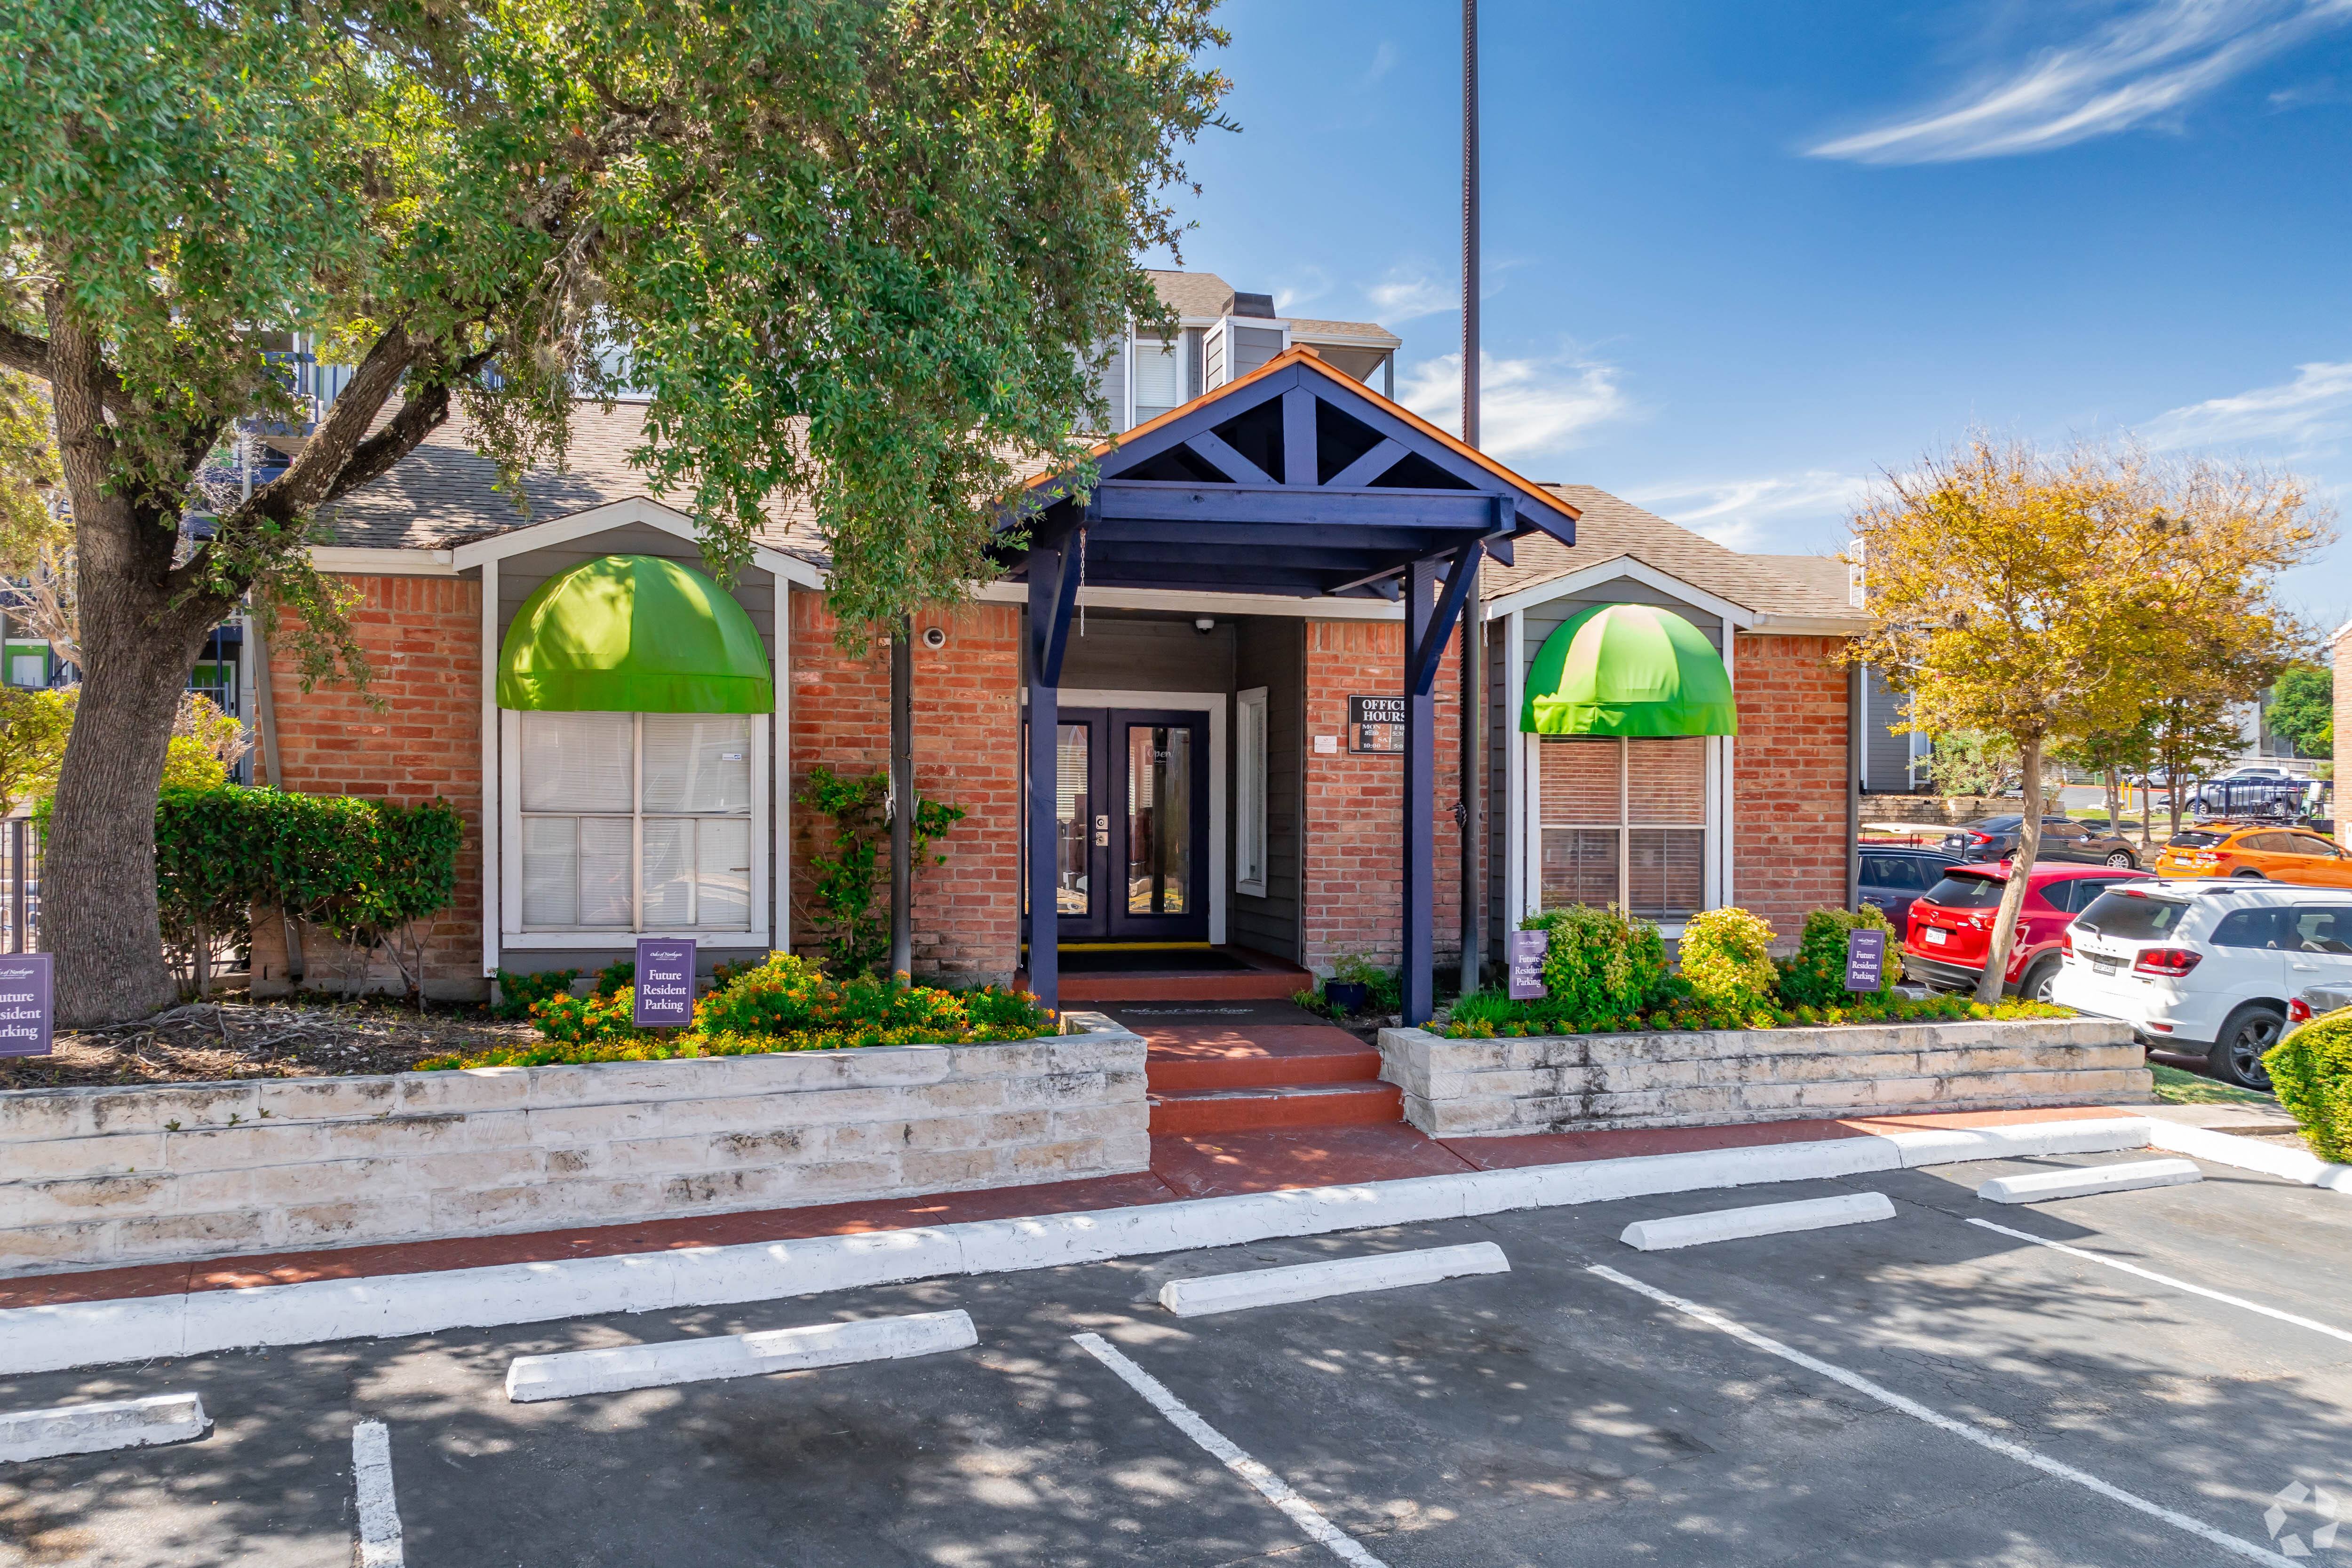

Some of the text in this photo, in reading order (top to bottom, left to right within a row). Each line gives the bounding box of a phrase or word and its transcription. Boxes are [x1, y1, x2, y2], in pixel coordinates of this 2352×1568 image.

[1363, 711, 1405, 721] HOURS
[1147, 748, 1172, 760] Open
[1856, 950, 1876, 959] Future
[1851, 961, 1877, 969] Resident
[649, 969, 682, 980] Future
[1852, 971, 1875, 982] Parking
[1517, 977, 1541, 988] Parking
[643, 983, 686, 995] Resident
[0, 993, 34, 1003] uture
[644, 998, 683, 1013] Parking
[0, 1006, 41, 1020] sident
[0, 1024, 38, 1040] rking
